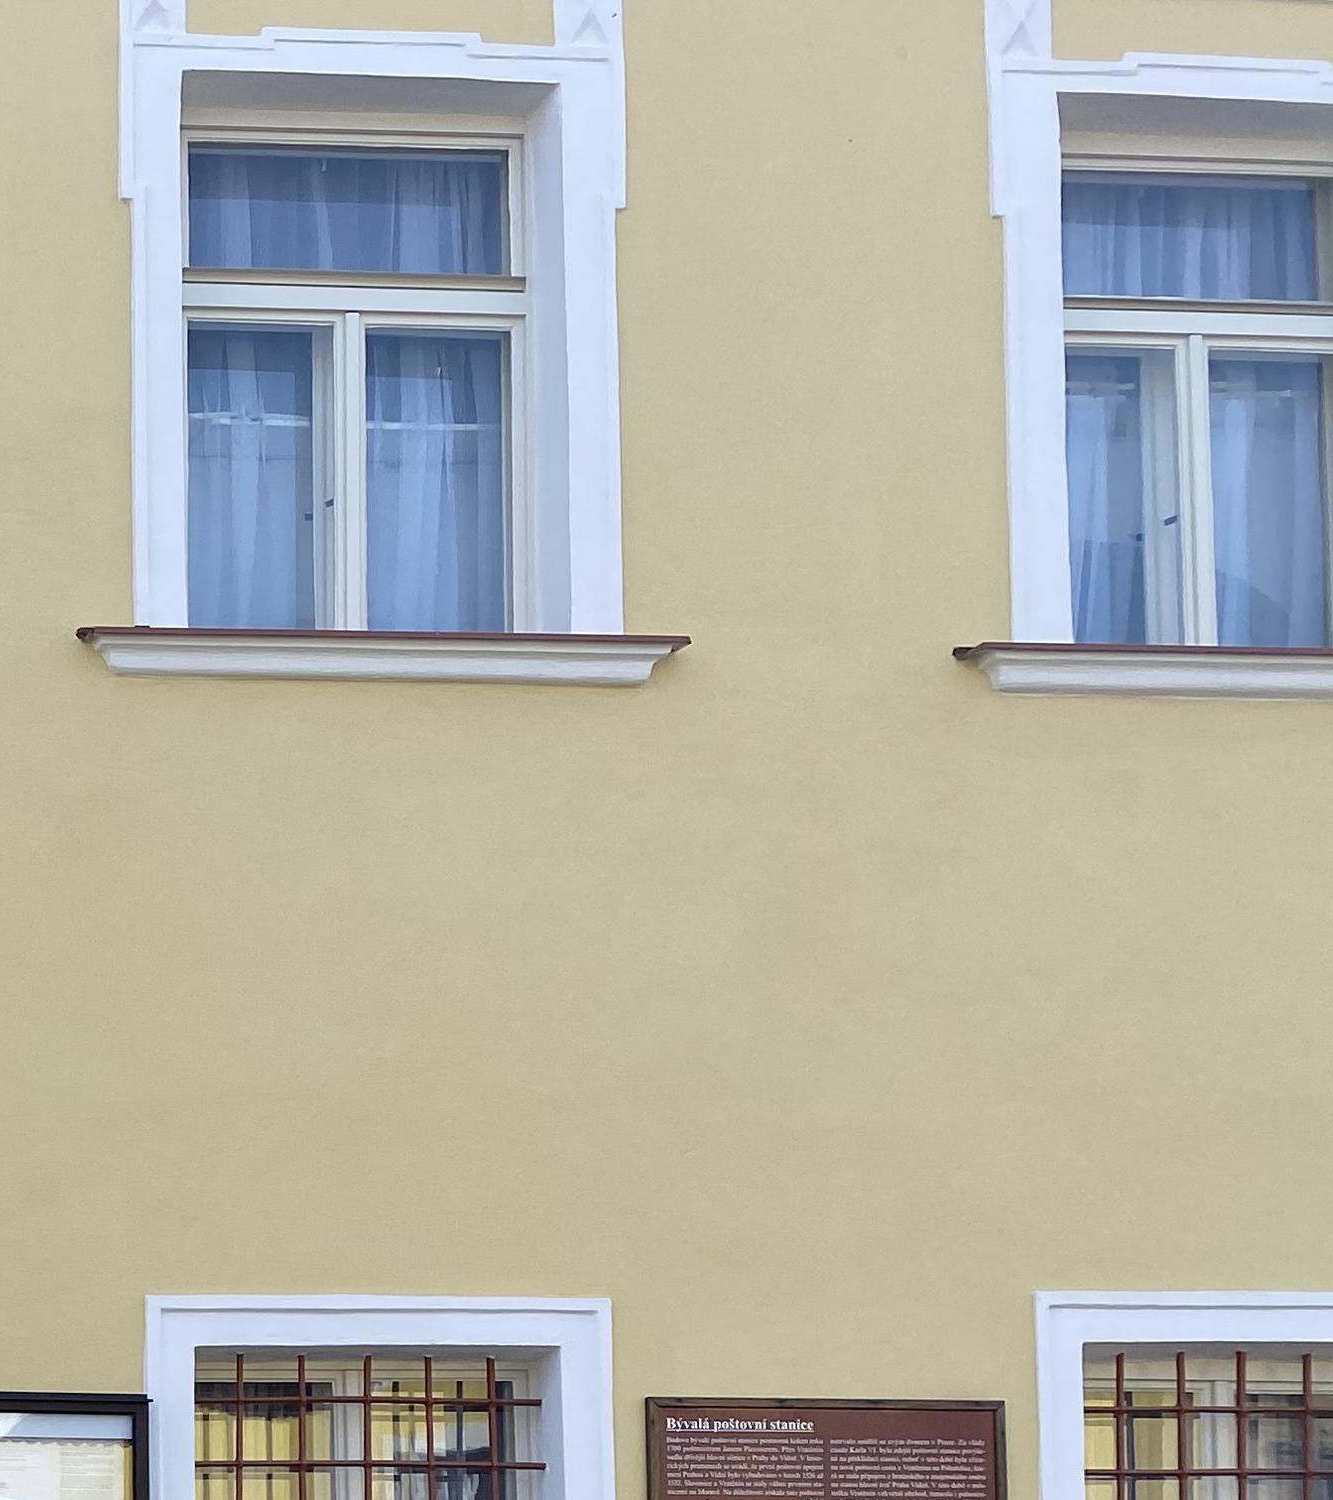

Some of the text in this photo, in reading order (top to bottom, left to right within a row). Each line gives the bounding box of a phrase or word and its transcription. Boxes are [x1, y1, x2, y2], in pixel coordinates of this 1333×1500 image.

[666, 1417, 814, 1432] Bývalá poštovní stanice
